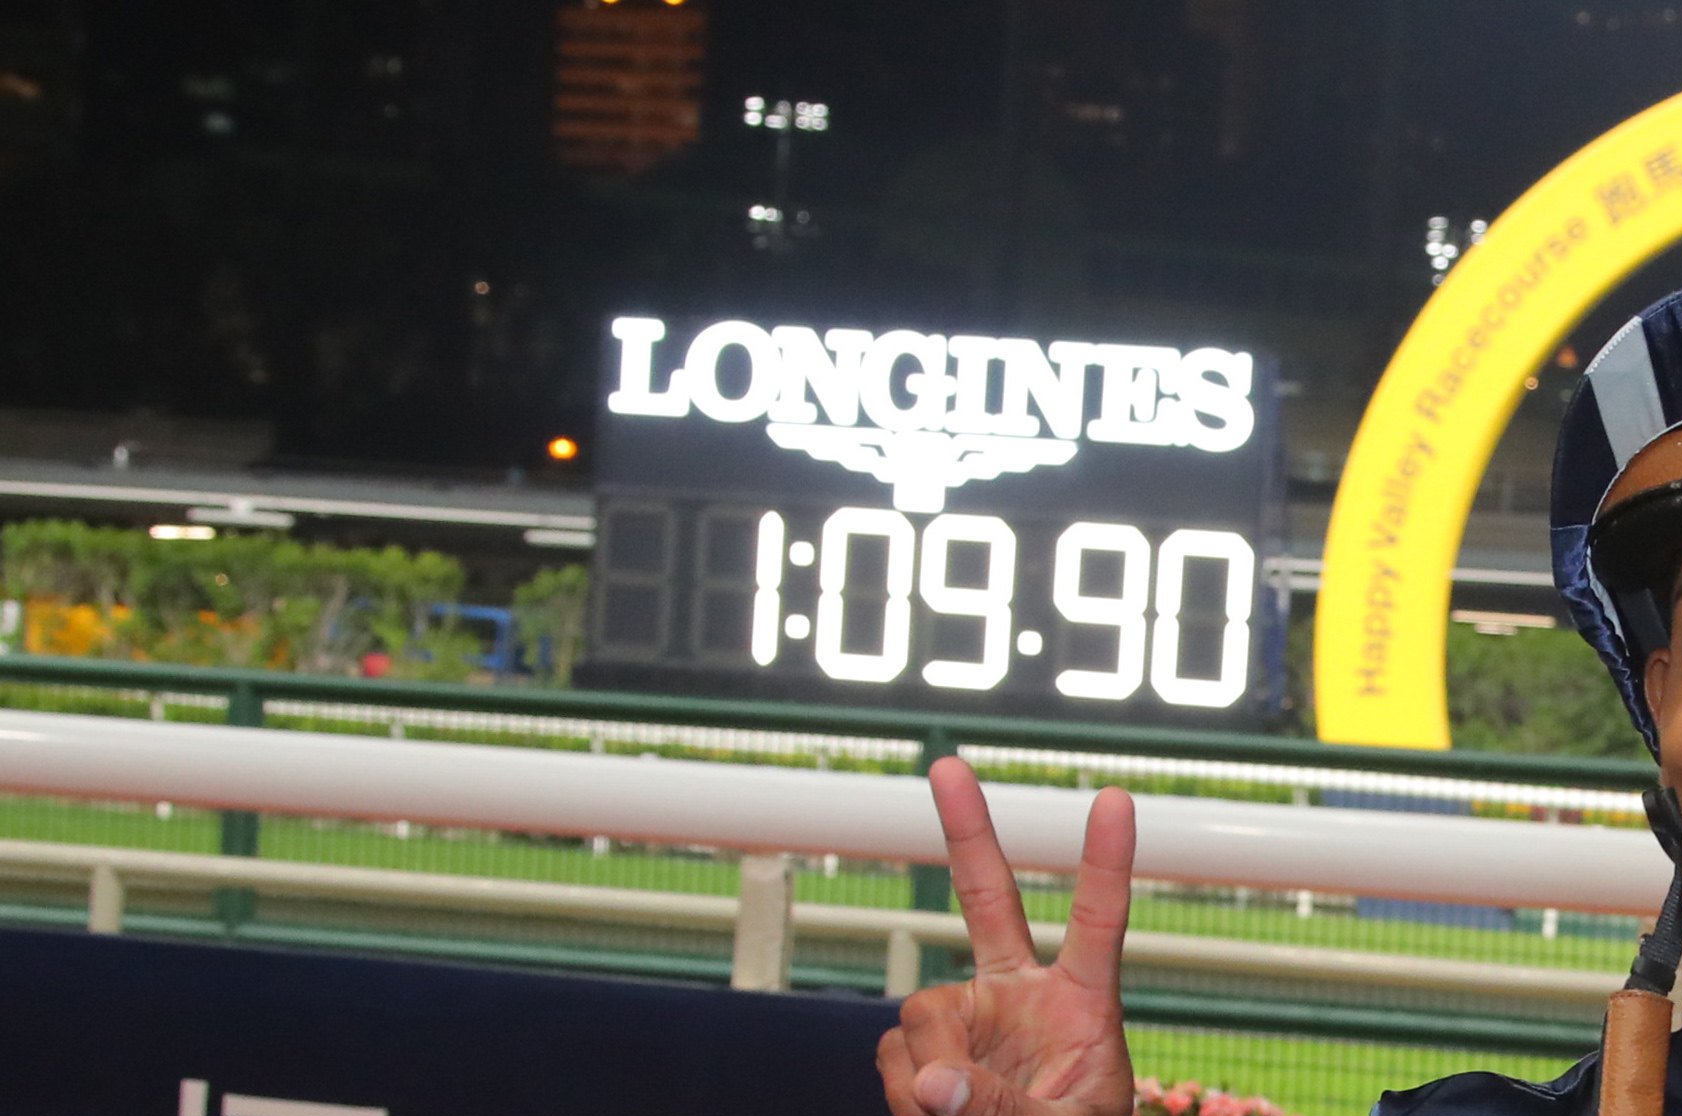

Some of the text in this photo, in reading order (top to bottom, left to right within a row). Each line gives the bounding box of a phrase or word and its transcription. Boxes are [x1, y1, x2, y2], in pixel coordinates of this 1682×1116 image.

[608, 316, 1254, 453] LONGINES
[1355, 217, 1589, 698] Happy Valley Racecourse
[752, 506, 1256, 708] 1:09.90
